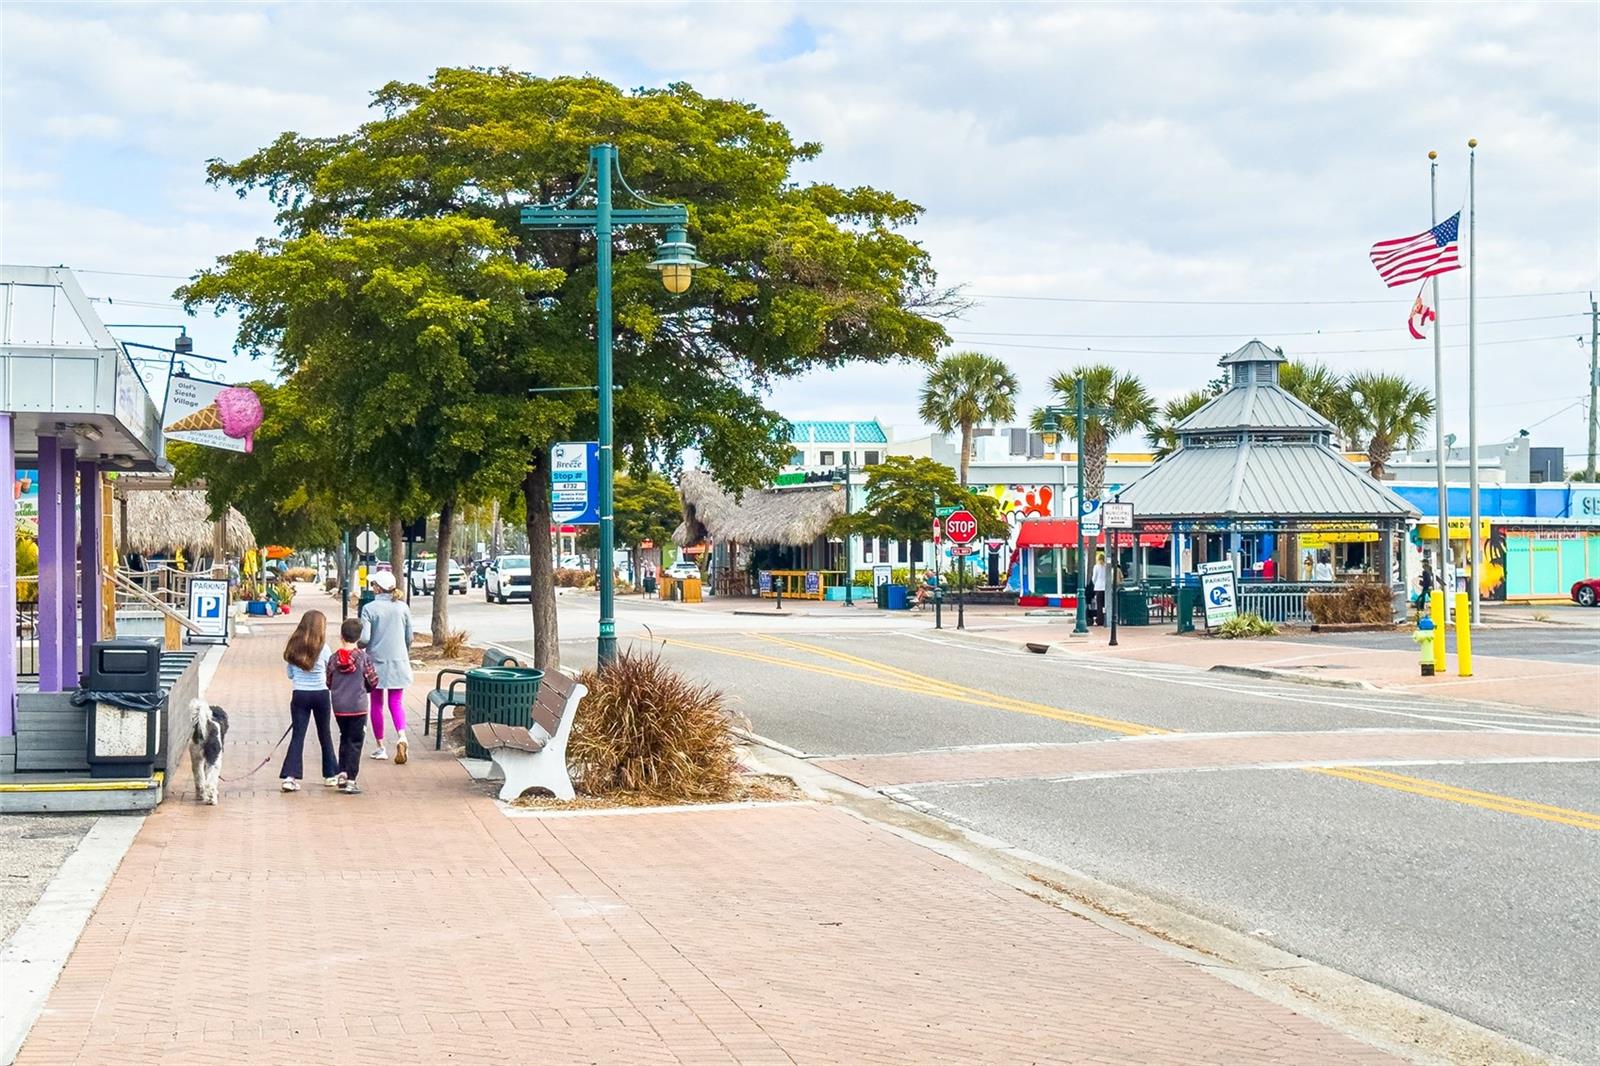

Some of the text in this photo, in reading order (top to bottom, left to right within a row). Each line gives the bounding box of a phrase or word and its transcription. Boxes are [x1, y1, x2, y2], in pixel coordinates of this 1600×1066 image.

[174, 389, 196, 398] Siesta
[173, 397, 199, 407] Village
[556, 461, 582, 469] Breeze
[553, 472, 583, 481] Stop #
[948, 520, 975, 533] STOP
[1204, 575, 1232, 585] PARKING
[194, 582, 226, 591] PARKING
[201, 596, 217, 618] P
